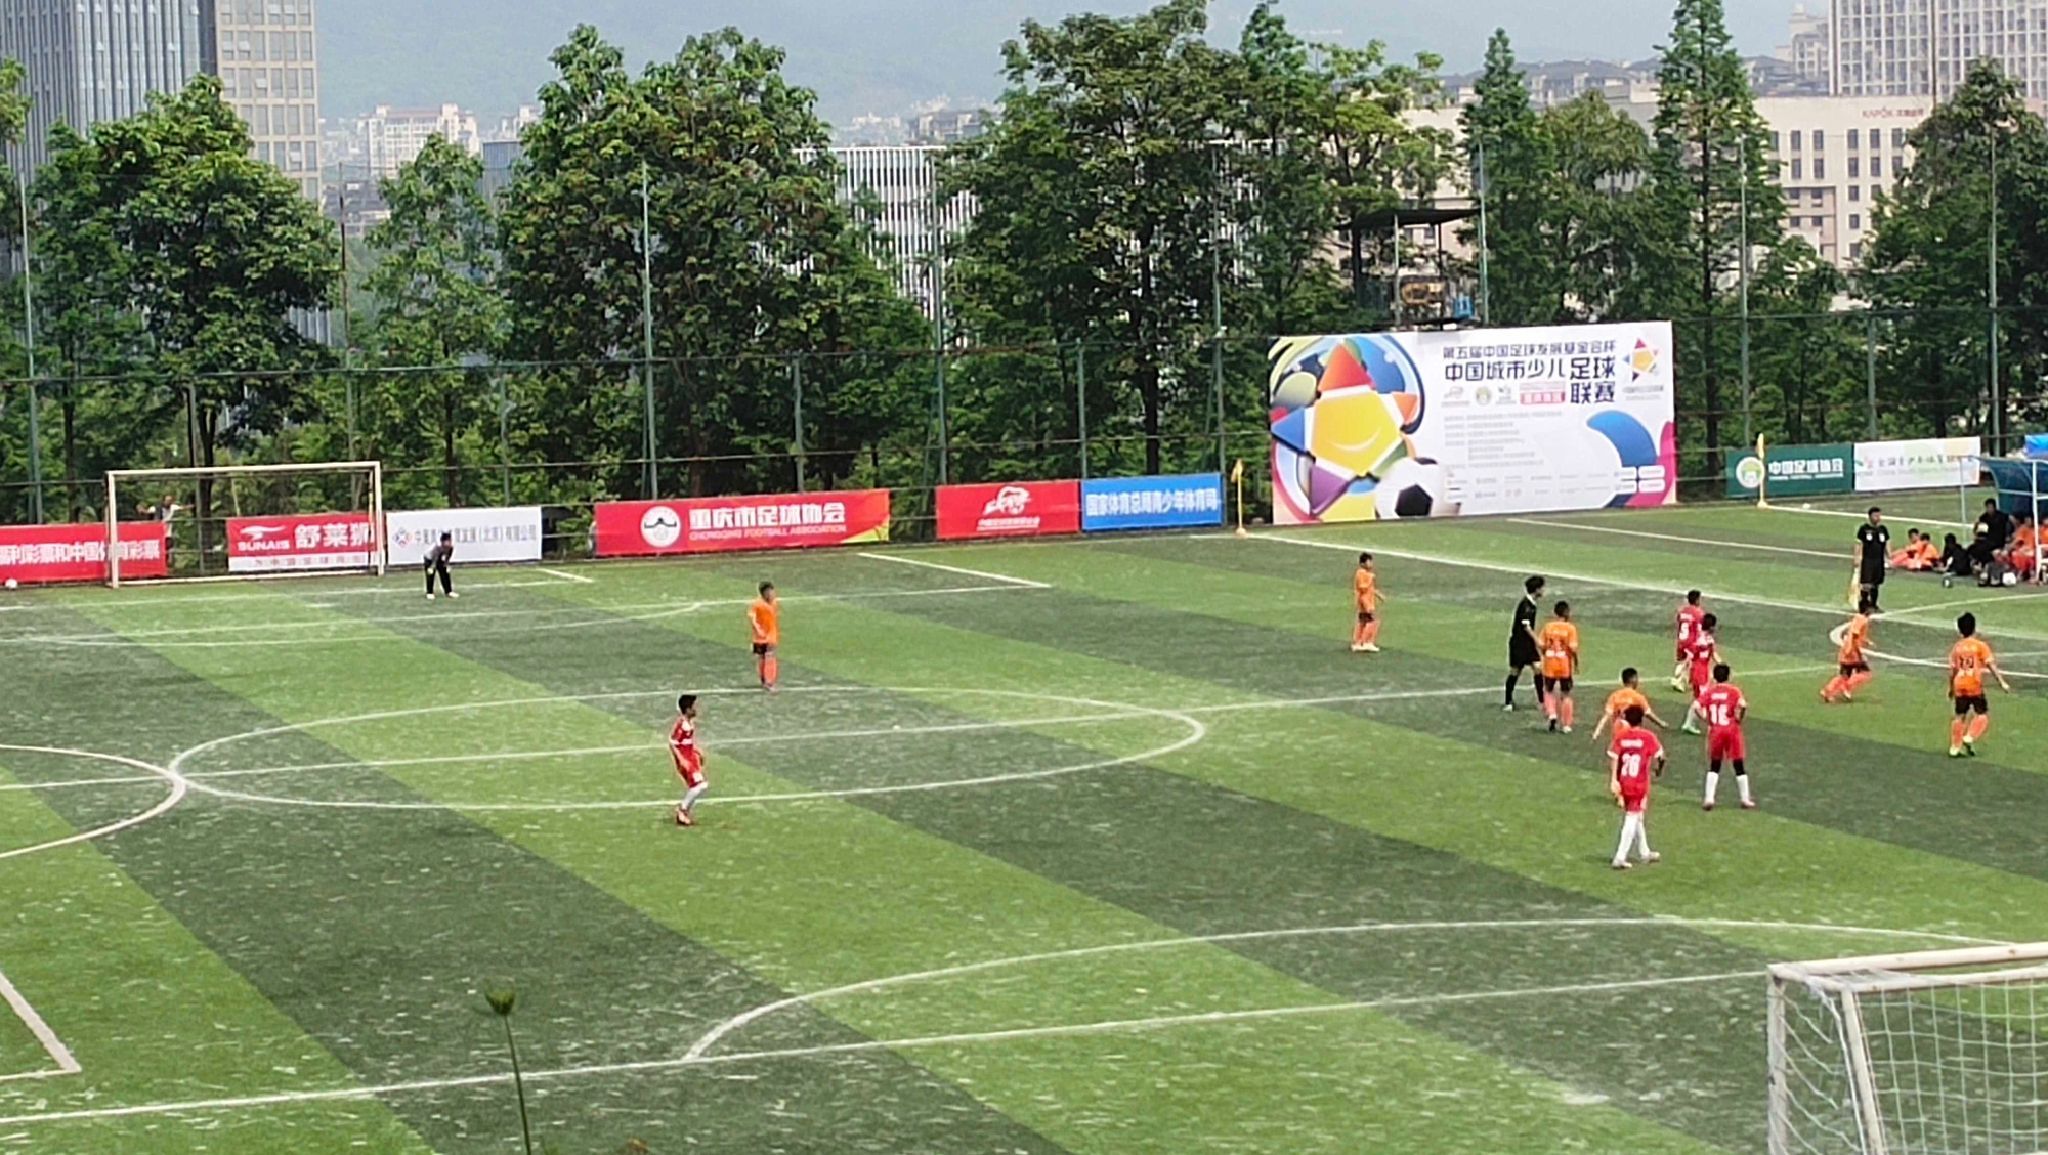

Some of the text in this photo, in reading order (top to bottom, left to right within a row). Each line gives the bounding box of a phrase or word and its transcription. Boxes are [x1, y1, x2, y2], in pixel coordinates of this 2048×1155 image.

[1570, 381, 1616, 404] 联赛
[689, 502, 846, 530] 重庆市足球协会
